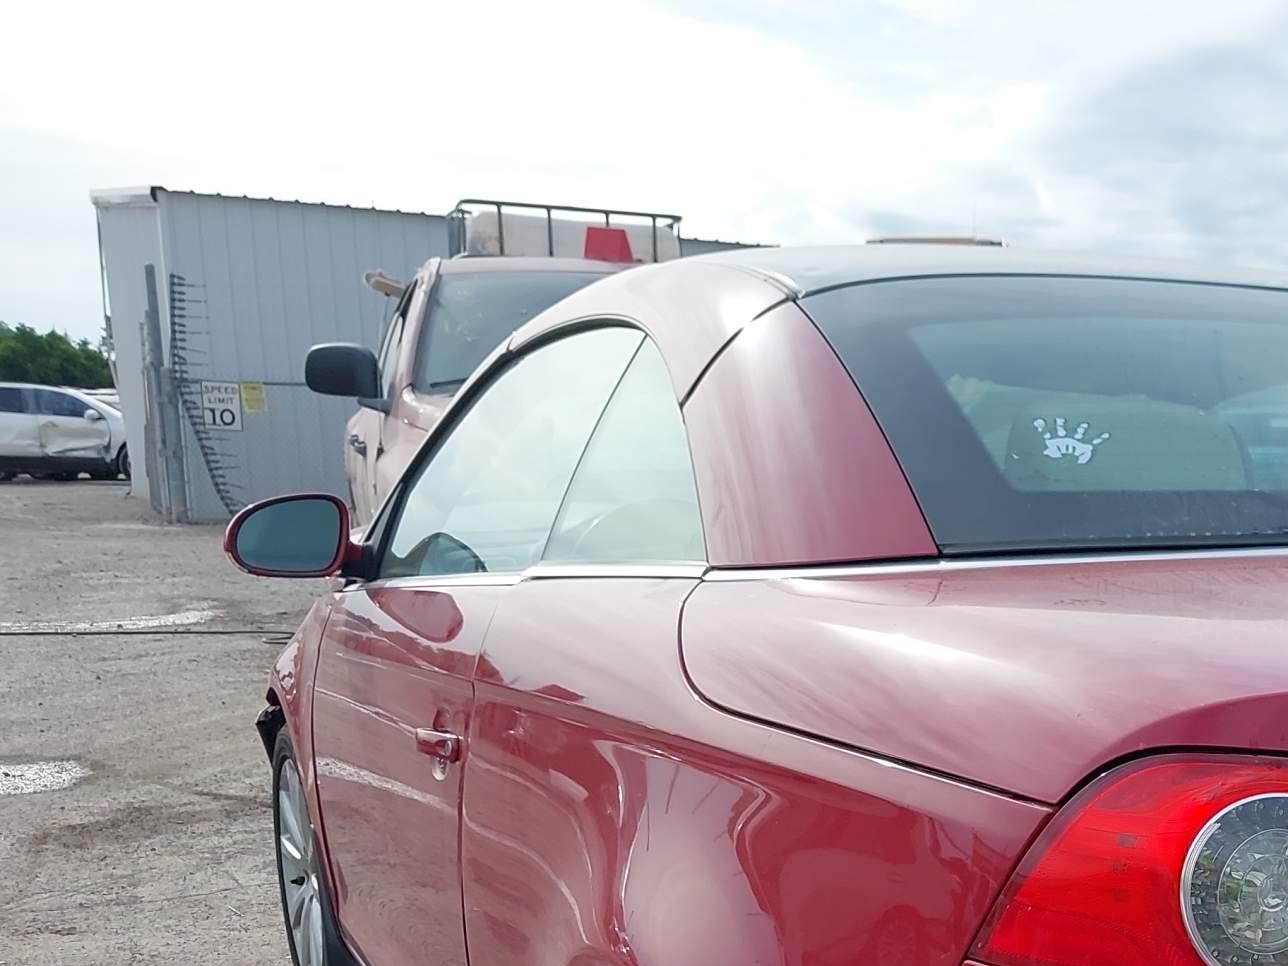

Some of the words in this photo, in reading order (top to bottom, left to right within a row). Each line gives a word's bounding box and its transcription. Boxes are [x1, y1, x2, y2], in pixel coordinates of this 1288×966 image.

[204, 385, 238, 396] SPEED
[208, 397, 235, 405] LIMIT
[208, 408, 236, 426] 10
